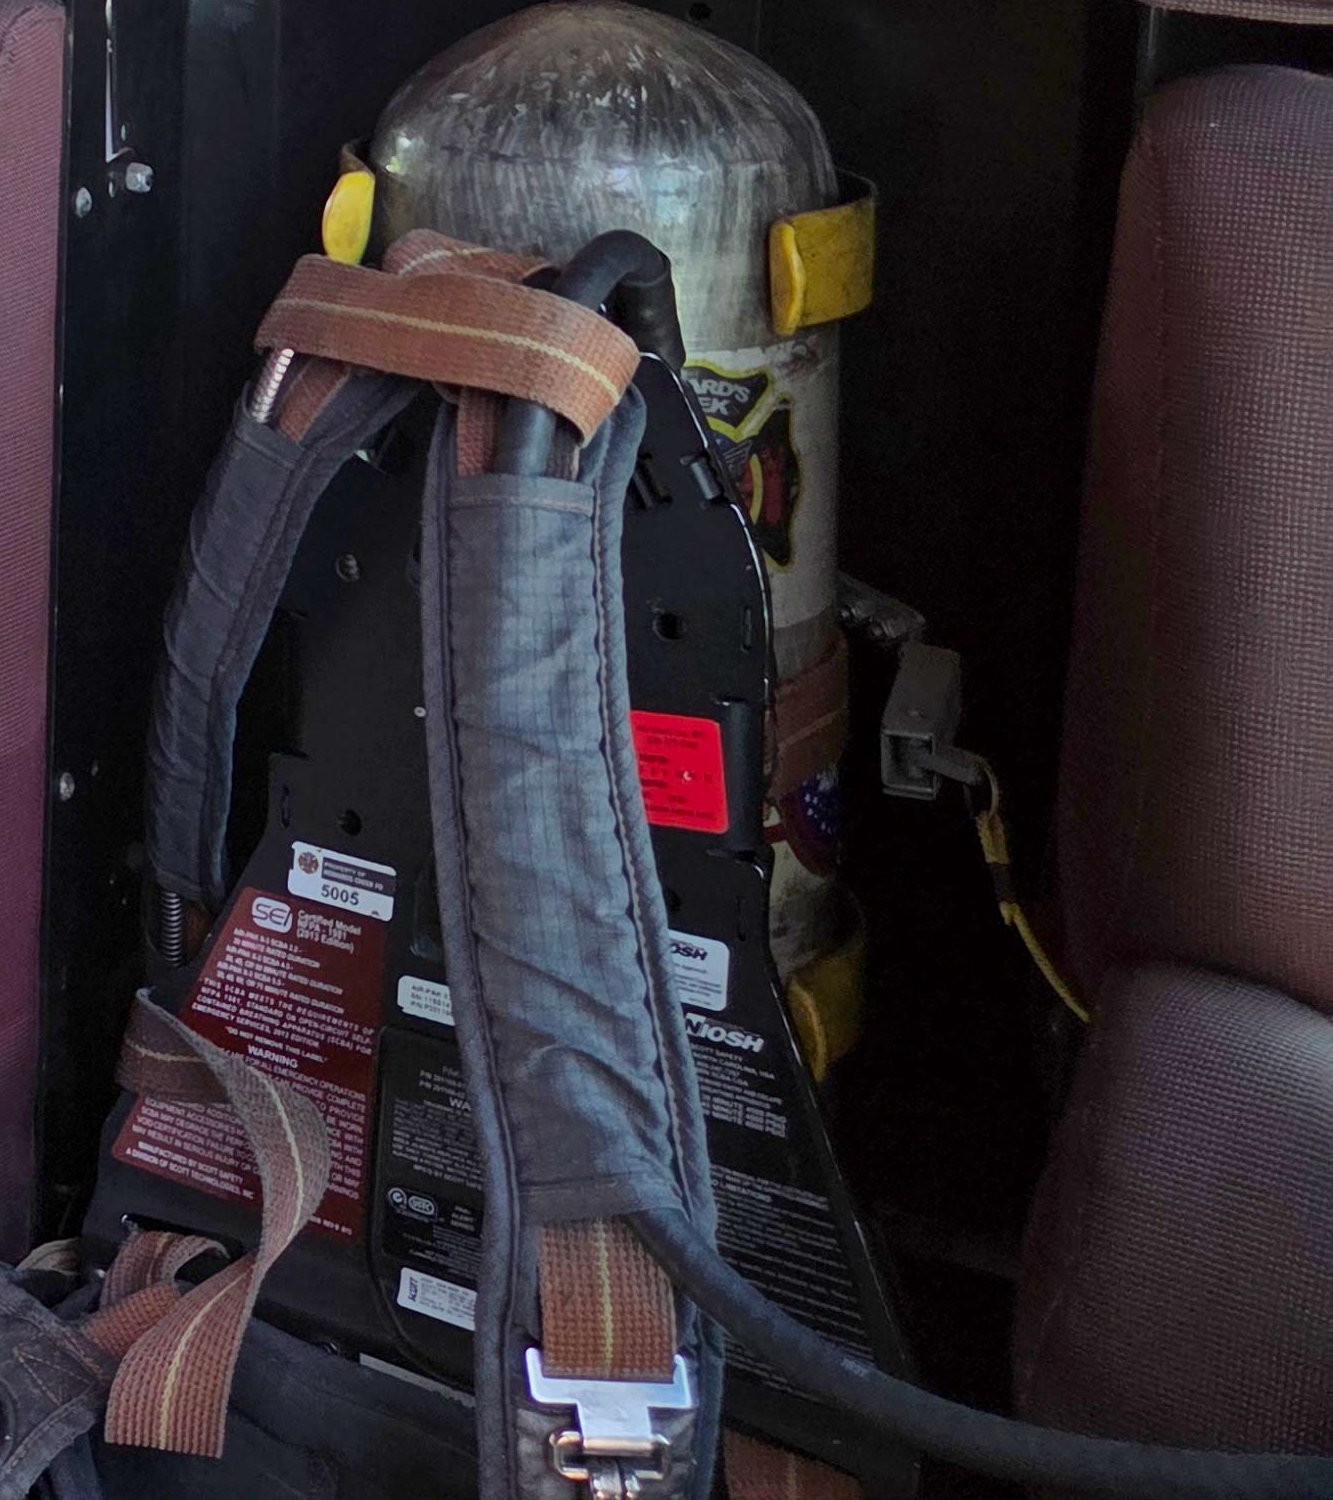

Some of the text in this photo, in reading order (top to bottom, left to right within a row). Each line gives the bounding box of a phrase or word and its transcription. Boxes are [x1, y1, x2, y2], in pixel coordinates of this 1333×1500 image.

[321, 884, 359, 906] 5005
[298, 910, 333, 927] Certified
[335, 920, 362, 935] Model
[321, 934, 355, 954] Edition)
[224, 984, 246, 997] SCBA
[296, 1006, 360, 1032] REQUIREMENTS
[684, 1013, 765, 1053] NIOSH
[246, 1044, 299, 1069] WARNING
